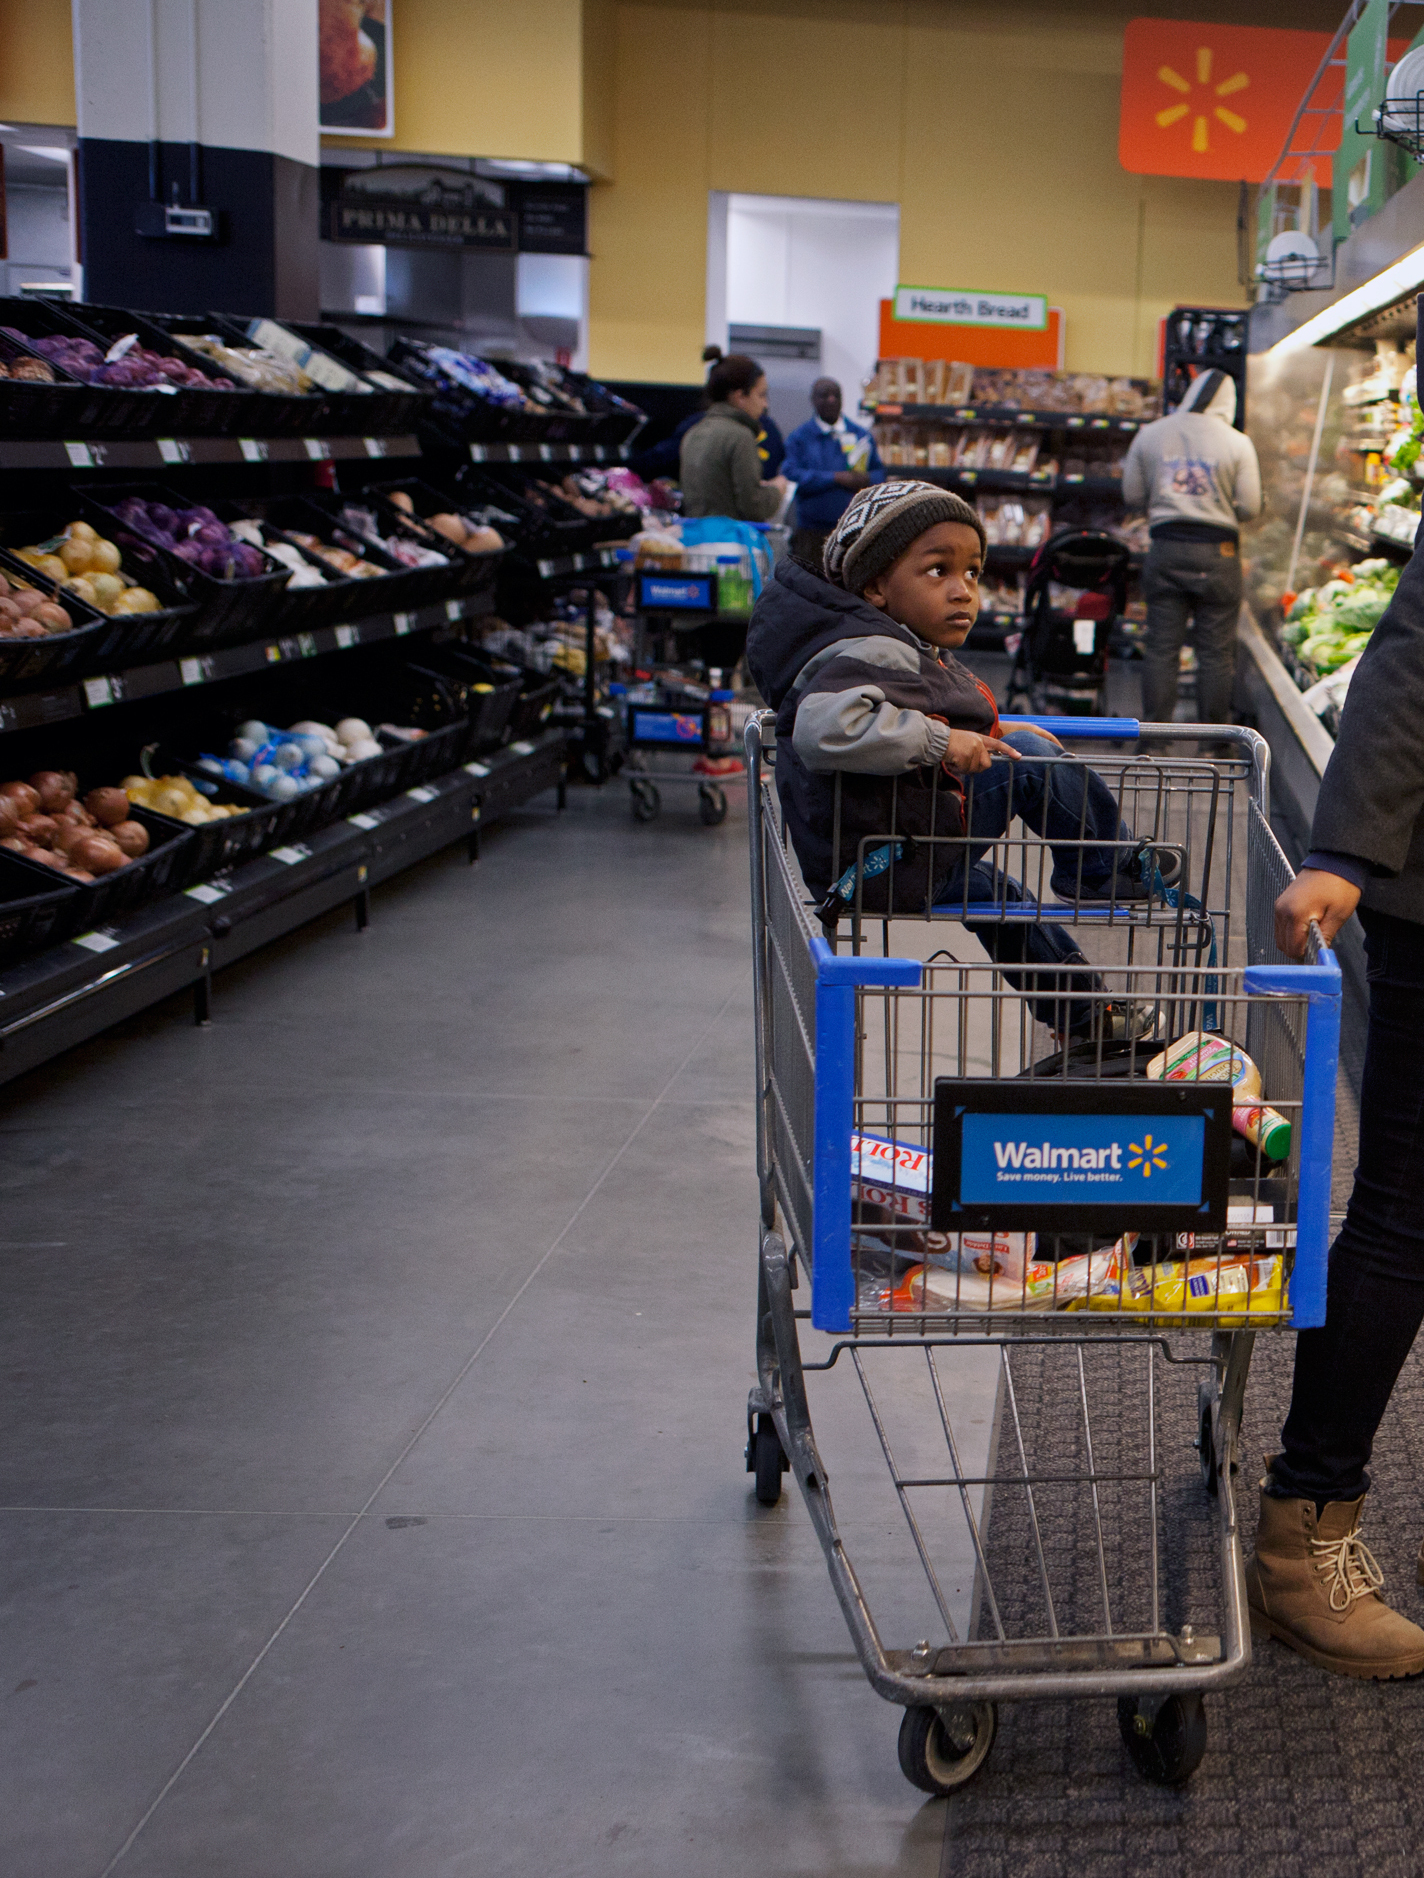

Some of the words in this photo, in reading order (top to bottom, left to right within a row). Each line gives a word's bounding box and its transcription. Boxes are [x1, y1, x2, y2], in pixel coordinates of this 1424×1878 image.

[342, 208, 422, 231] PRIMA
[429, 213, 508, 237] DELLA
[911, 295, 973, 315] Hearth
[978, 300, 1029, 318] Bread
[994, 1142, 1122, 1169] Walmart
[997, 1172, 1021, 1182] Save
[1023, 1173, 1061, 1183] money.
[1064, 1172, 1085, 1182] Live
[1087, 1172, 1123, 1182] better.
